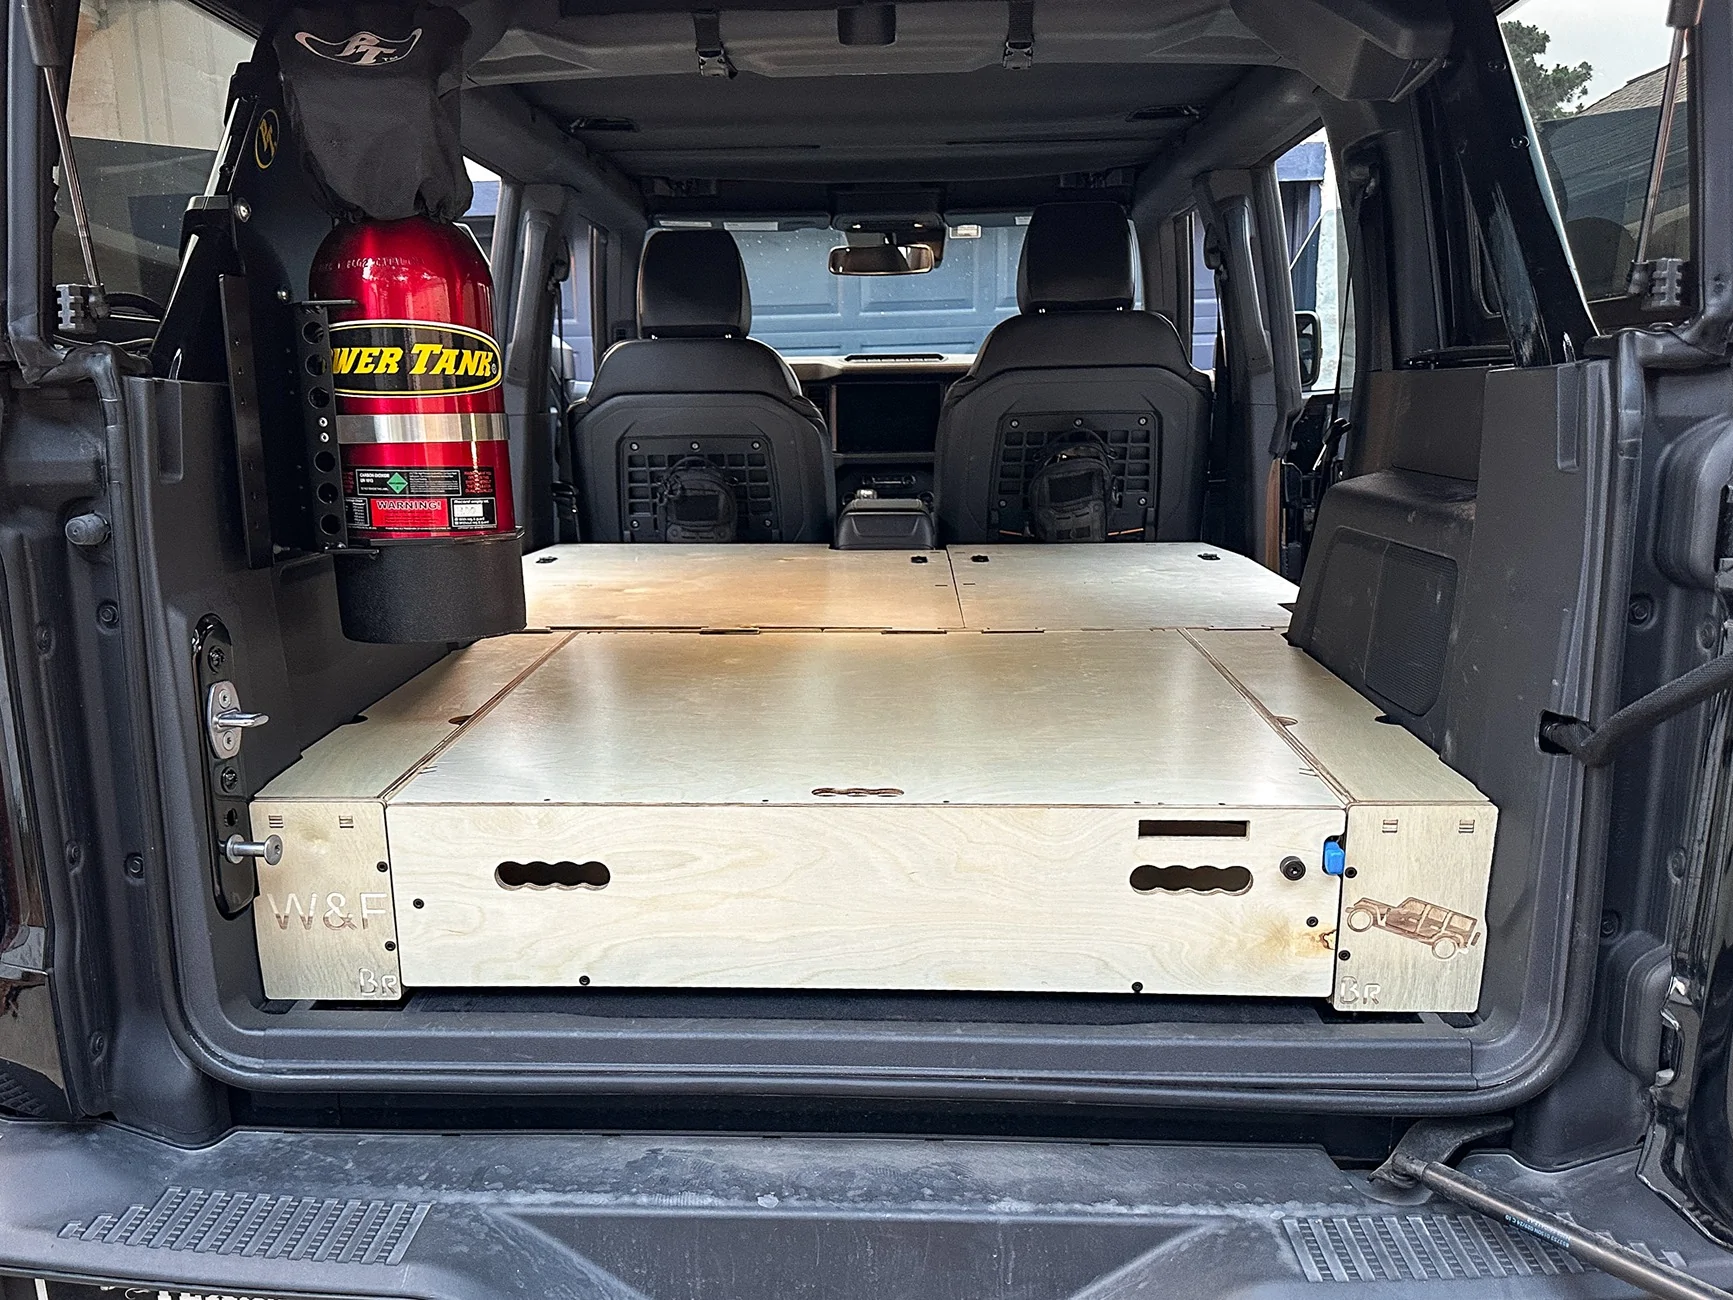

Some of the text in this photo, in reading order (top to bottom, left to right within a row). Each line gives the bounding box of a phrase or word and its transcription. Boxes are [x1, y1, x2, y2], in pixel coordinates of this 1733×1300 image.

[331, 343, 493, 377] WER TANK
[376, 500, 442, 511] WARNING!
[266, 891, 388, 931] W&F
